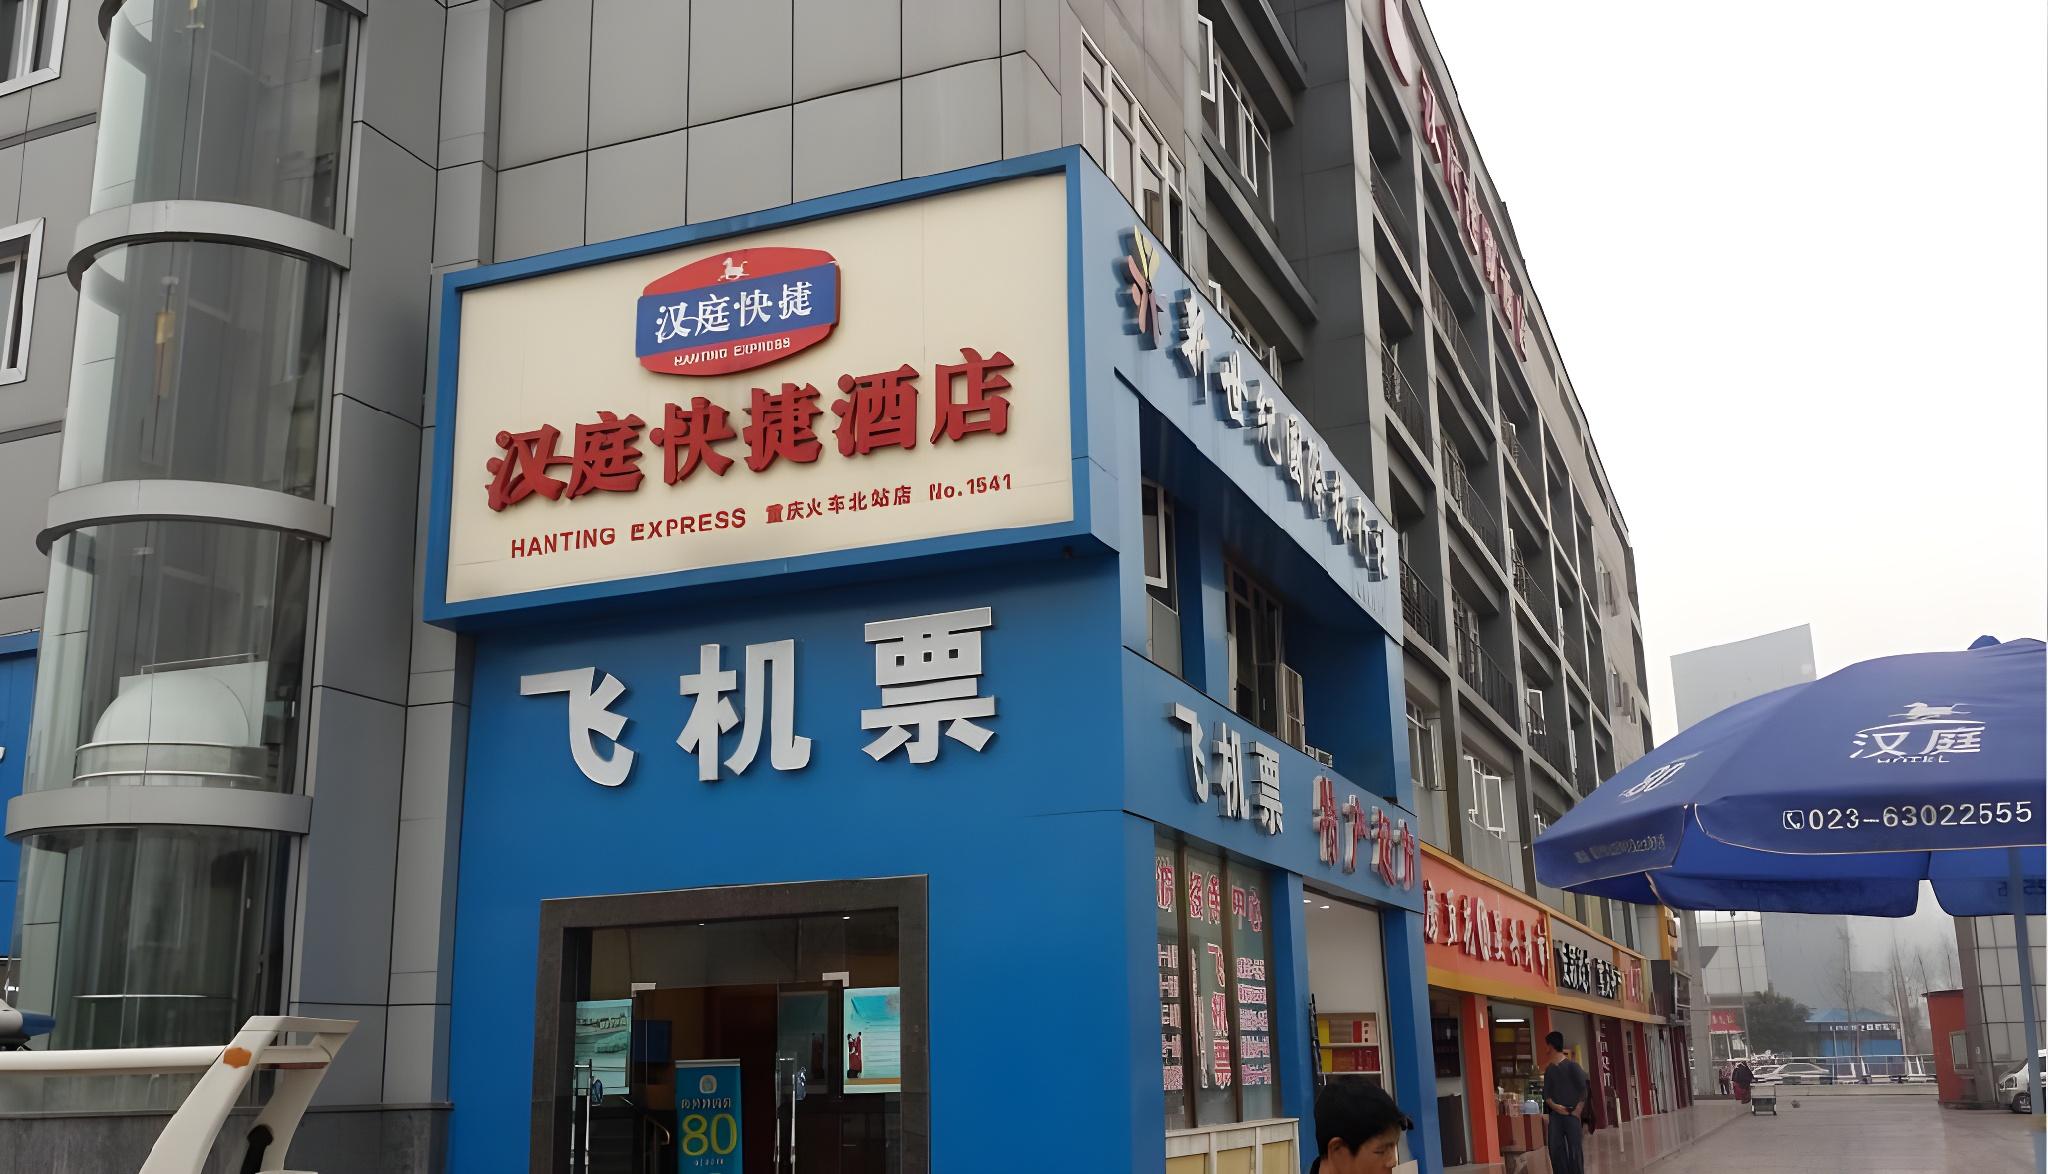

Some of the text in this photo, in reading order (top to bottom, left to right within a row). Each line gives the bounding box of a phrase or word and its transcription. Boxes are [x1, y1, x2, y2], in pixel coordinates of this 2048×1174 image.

[656, 281, 813, 344] 汉庭快捷
[484, 347, 1015, 512] 汉庭快捷酒店
[511, 473, 1013, 559] HANTING EXPRESS 重庆火车北站店 No.1541
[519, 606, 997, 788] 飞机票
[1166, 702, 1284, 836] 飞机票
[1849, 726, 1986, 759] 汉庭
[1808, 800, 2033, 831] 023-63022555
[682, 1113, 738, 1157] 80
